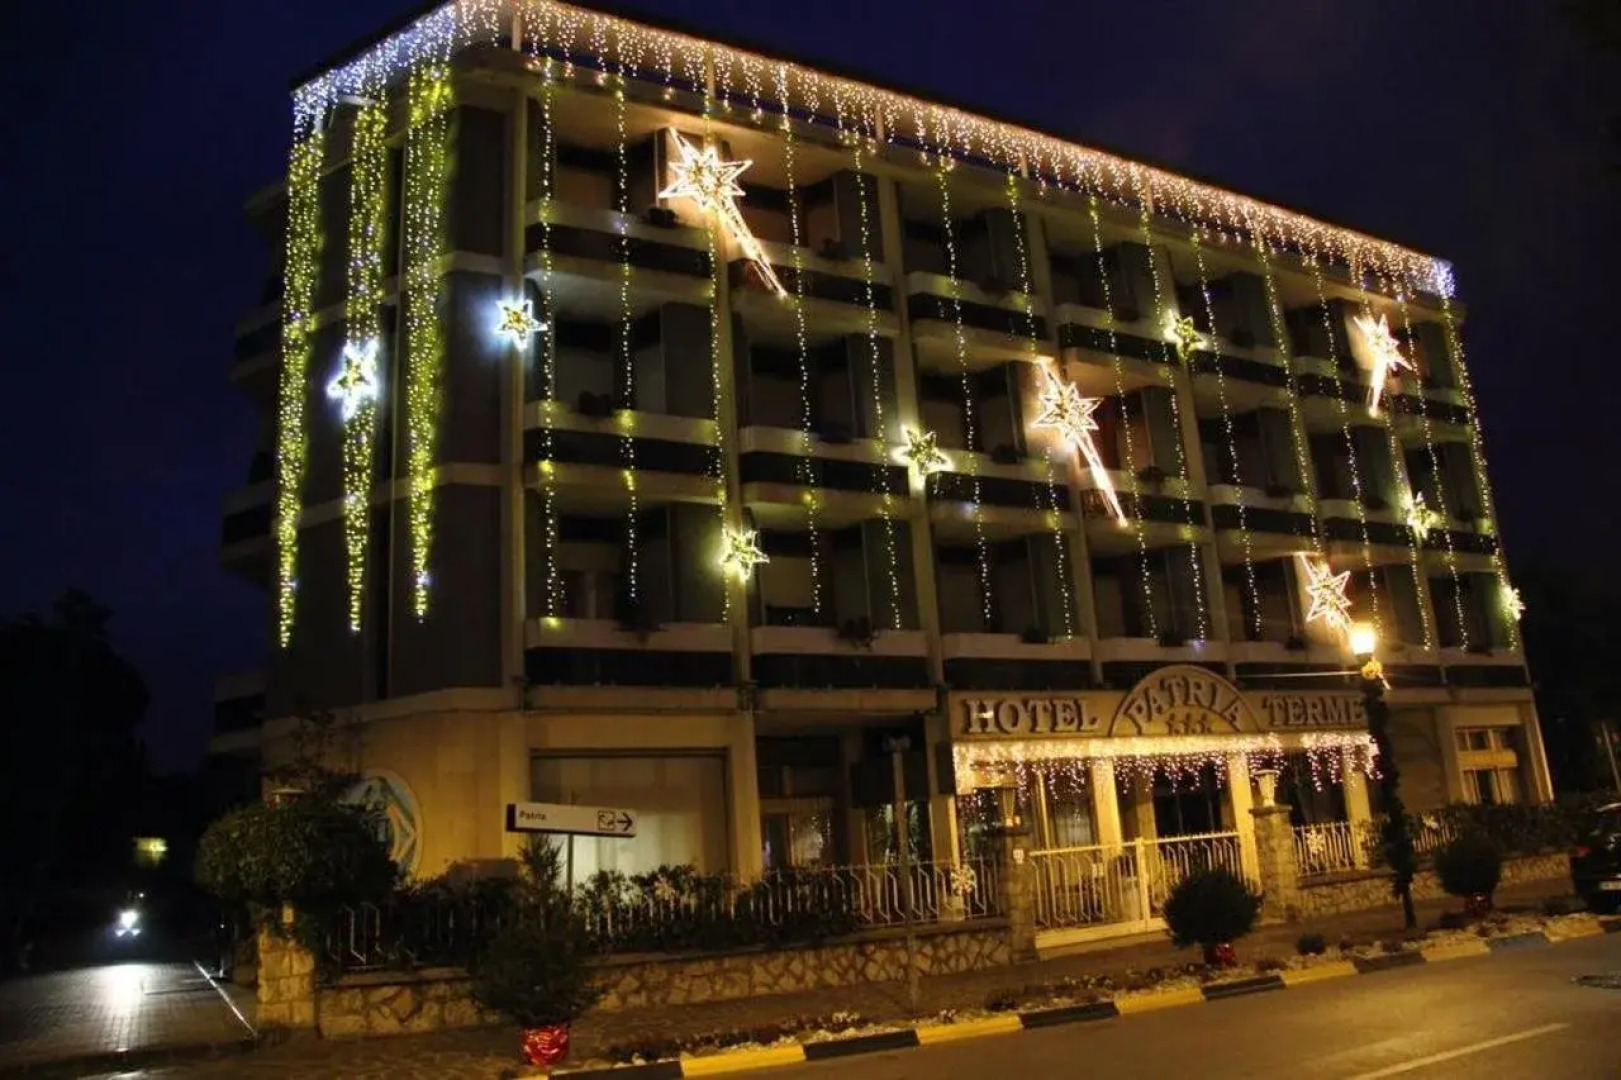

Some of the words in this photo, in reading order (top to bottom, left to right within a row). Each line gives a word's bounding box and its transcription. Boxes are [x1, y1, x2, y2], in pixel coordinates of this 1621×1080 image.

[963, 698, 1099, 734] HOTEL
[1122, 675, 1243, 735] PATRIA
[1262, 695, 1367, 726] TERME
